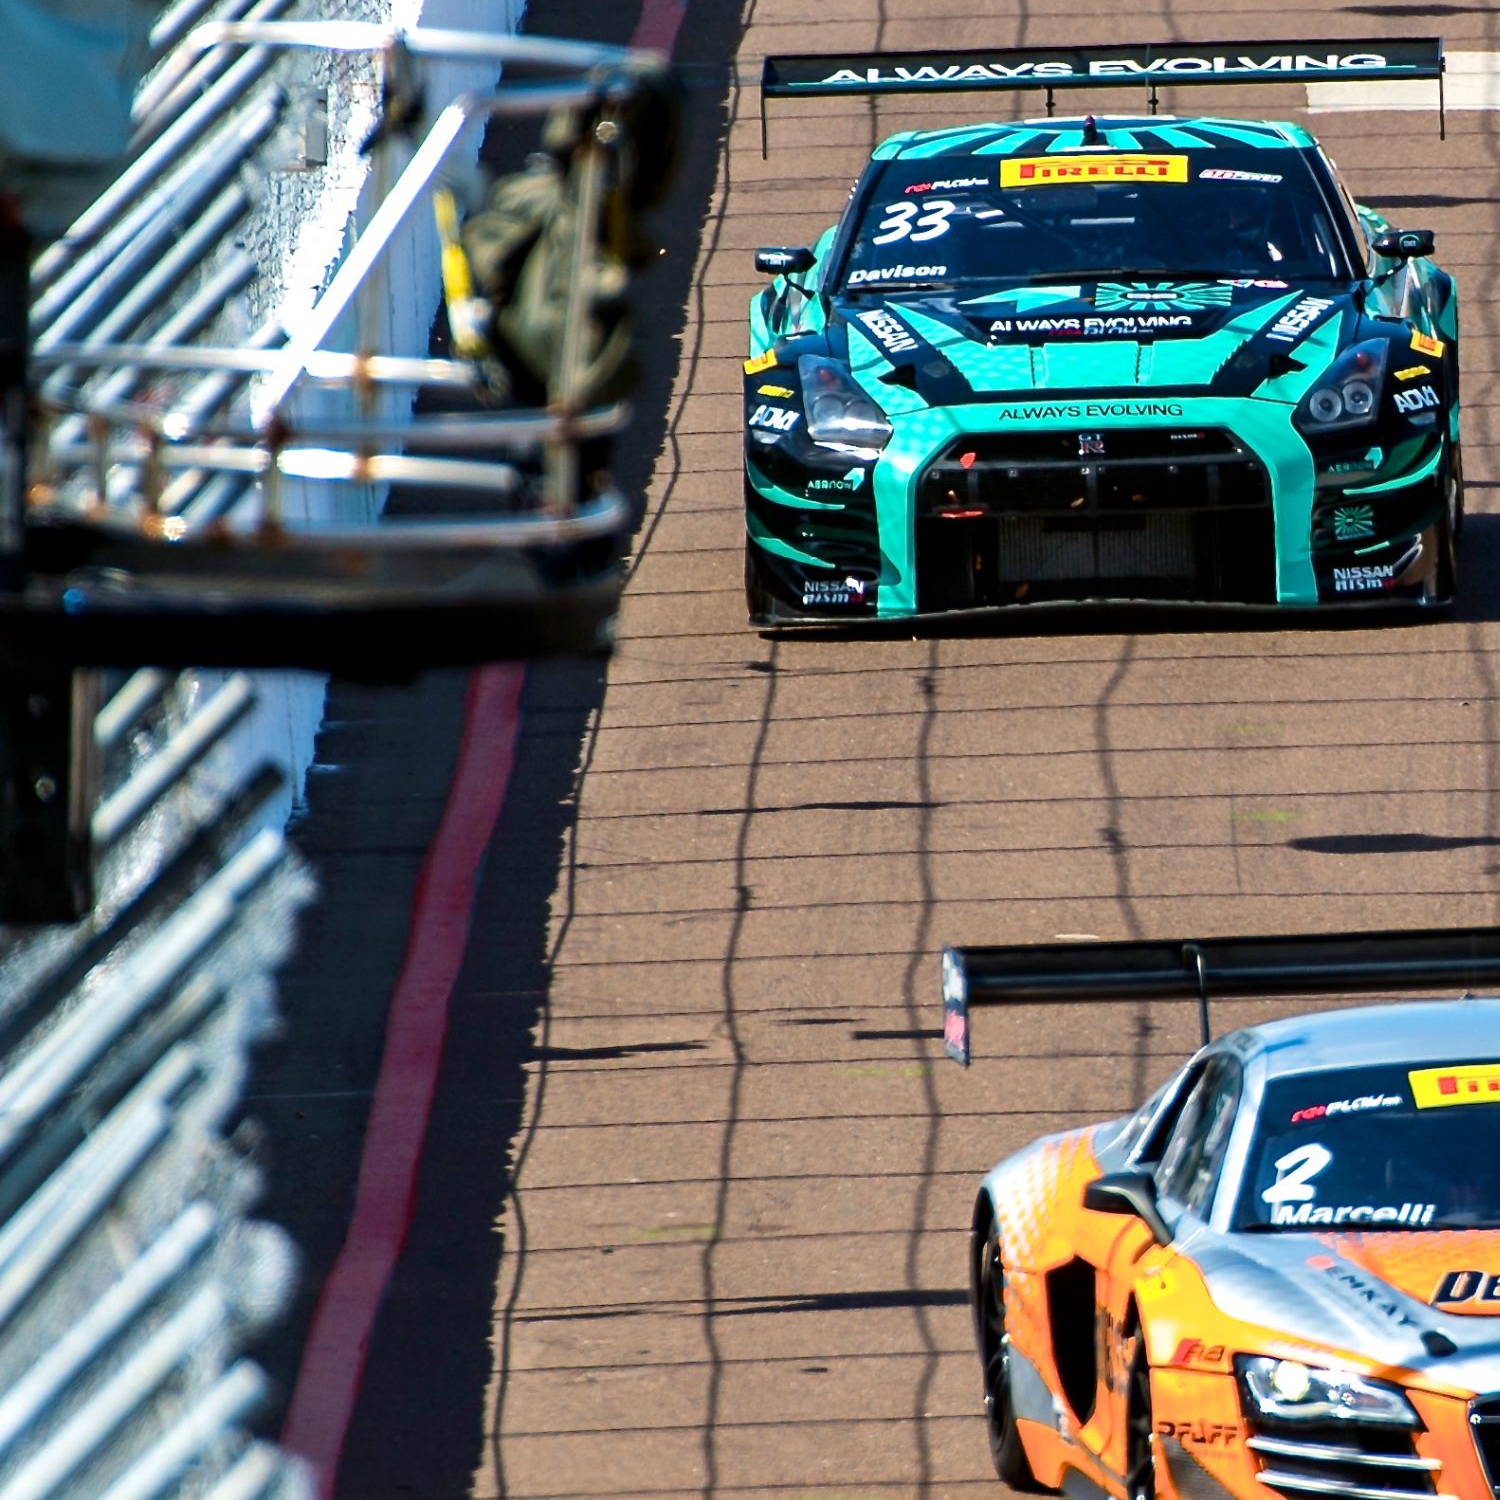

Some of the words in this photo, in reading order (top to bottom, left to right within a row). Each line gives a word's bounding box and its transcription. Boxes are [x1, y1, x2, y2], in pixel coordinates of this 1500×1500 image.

[821, 61, 1073, 84] ALWAYS
[1088, 53, 1387, 77] EVOLVING
[1020, 159, 1170, 180] PIRELLI
[873, 200, 955, 245] 33
[848, 265, 946, 284] Davison
[855, 309, 918, 353] NISSAN
[1267, 297, 1335, 342] NISSAN
[1000, 405, 1080, 420] ALWAYS
[1086, 403, 1183, 418] EVOLVING
[1333, 565, 1394, 580] NISSAN
[1262, 1143, 1333, 1202] 2
[1276, 1202, 1436, 1226] Marcelli
